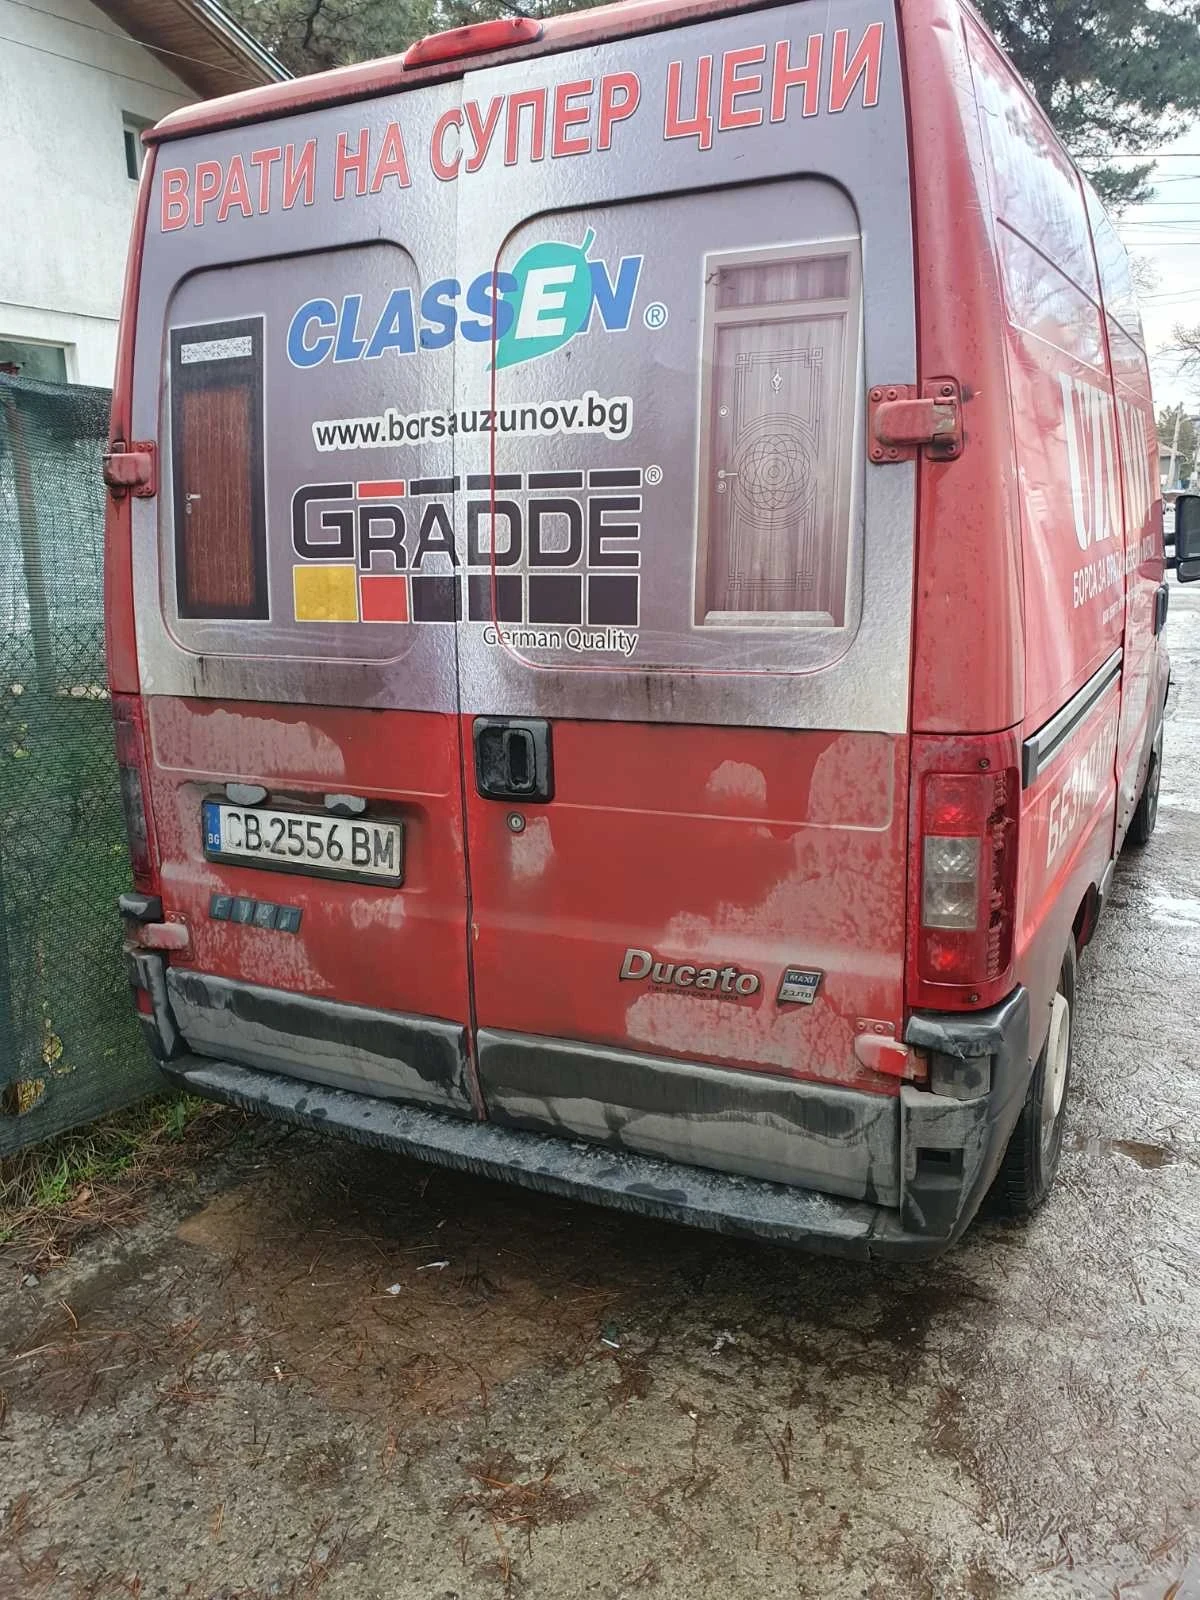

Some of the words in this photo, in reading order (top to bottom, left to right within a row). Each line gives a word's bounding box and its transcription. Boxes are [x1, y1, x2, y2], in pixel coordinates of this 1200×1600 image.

[161, 138, 317, 232] ВРАТИ
[333, 122, 411, 200] НА
[430, 71, 641, 181] СУПЕР
[663, 22, 884, 151] ЦЕНИ
[287, 254, 643, 369] CLASSEN
[315, 397, 629, 447] www.borsauzunov.bg
[292, 478, 642, 570] GRADDE
[483, 627, 561, 650] German
[566, 628, 638, 656] Quality
[208, 833, 220, 845] BG
[619, 948, 761, 995] Ducato
[789, 974, 816, 984] MAXI
